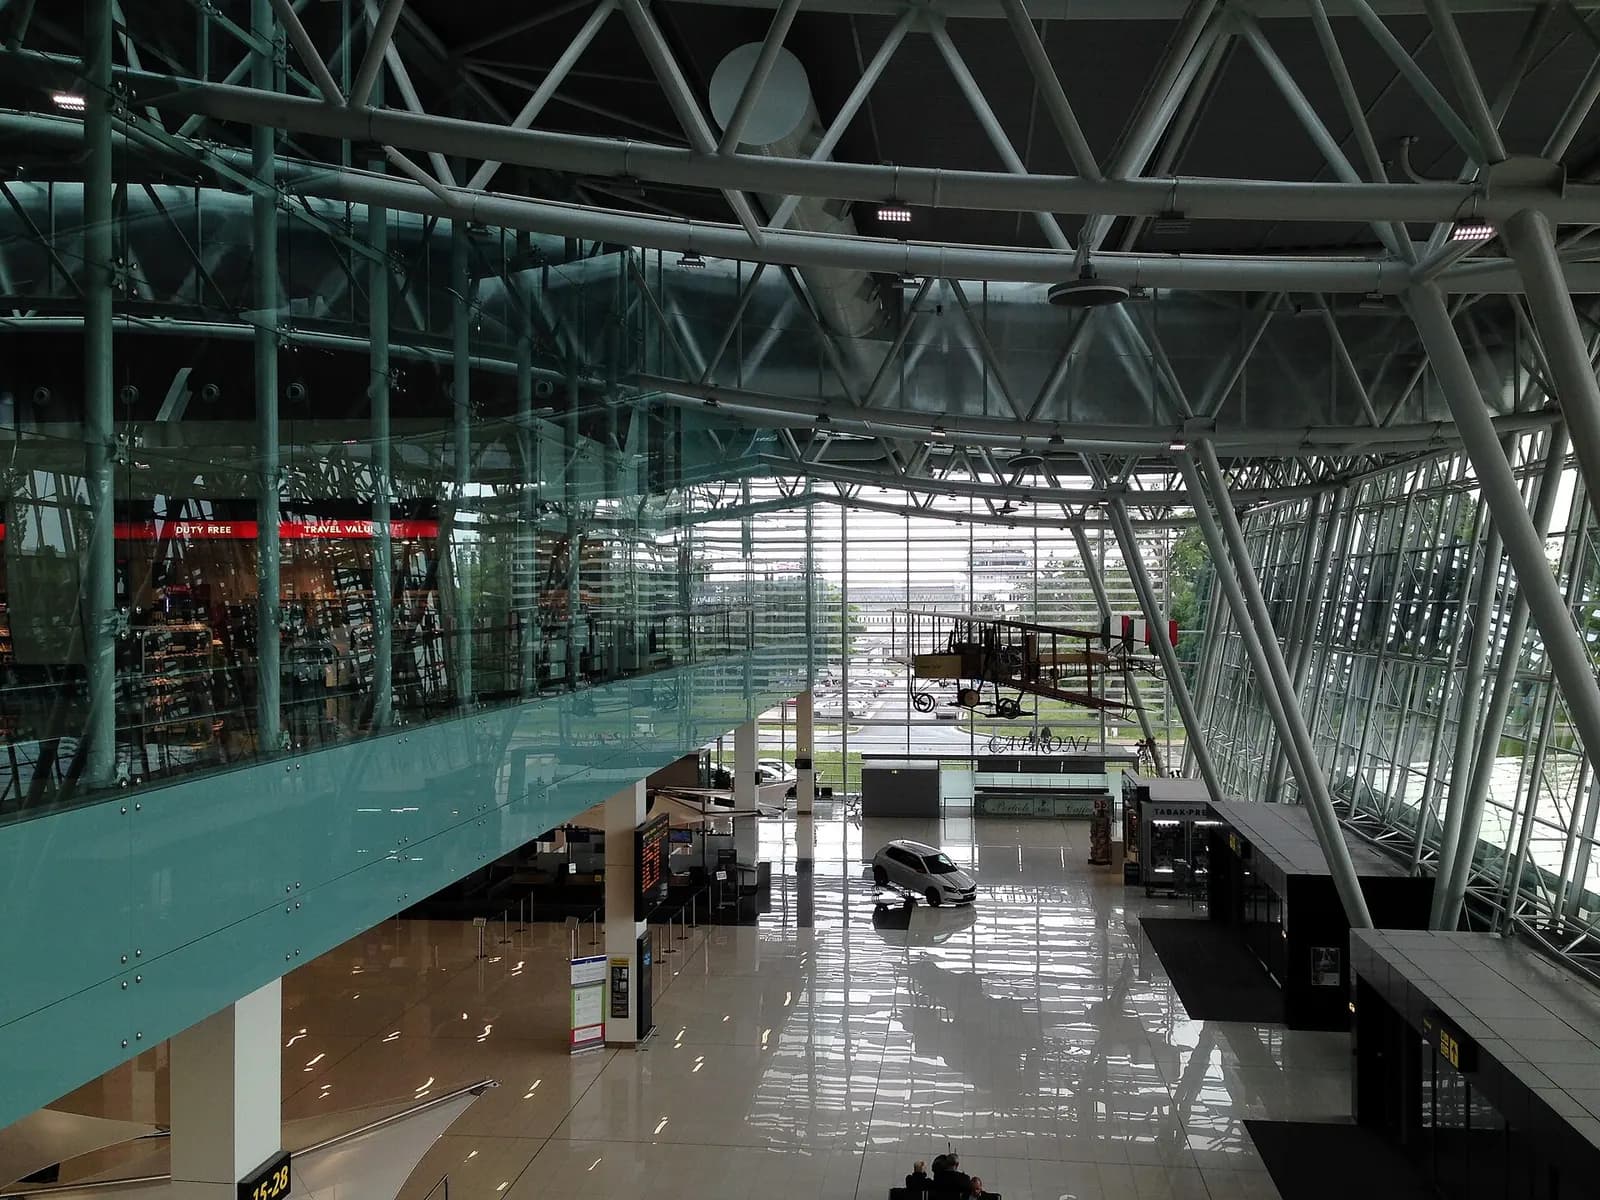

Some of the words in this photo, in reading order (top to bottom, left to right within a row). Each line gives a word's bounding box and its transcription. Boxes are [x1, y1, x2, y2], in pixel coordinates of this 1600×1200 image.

[176, 526, 204, 534] DUTY
[207, 526, 232, 534] FREE
[304, 525, 342, 534] TRAVEL
[981, 735, 1092, 754] CAPRONI
[252, 1164, 289, 1200] 15-28
